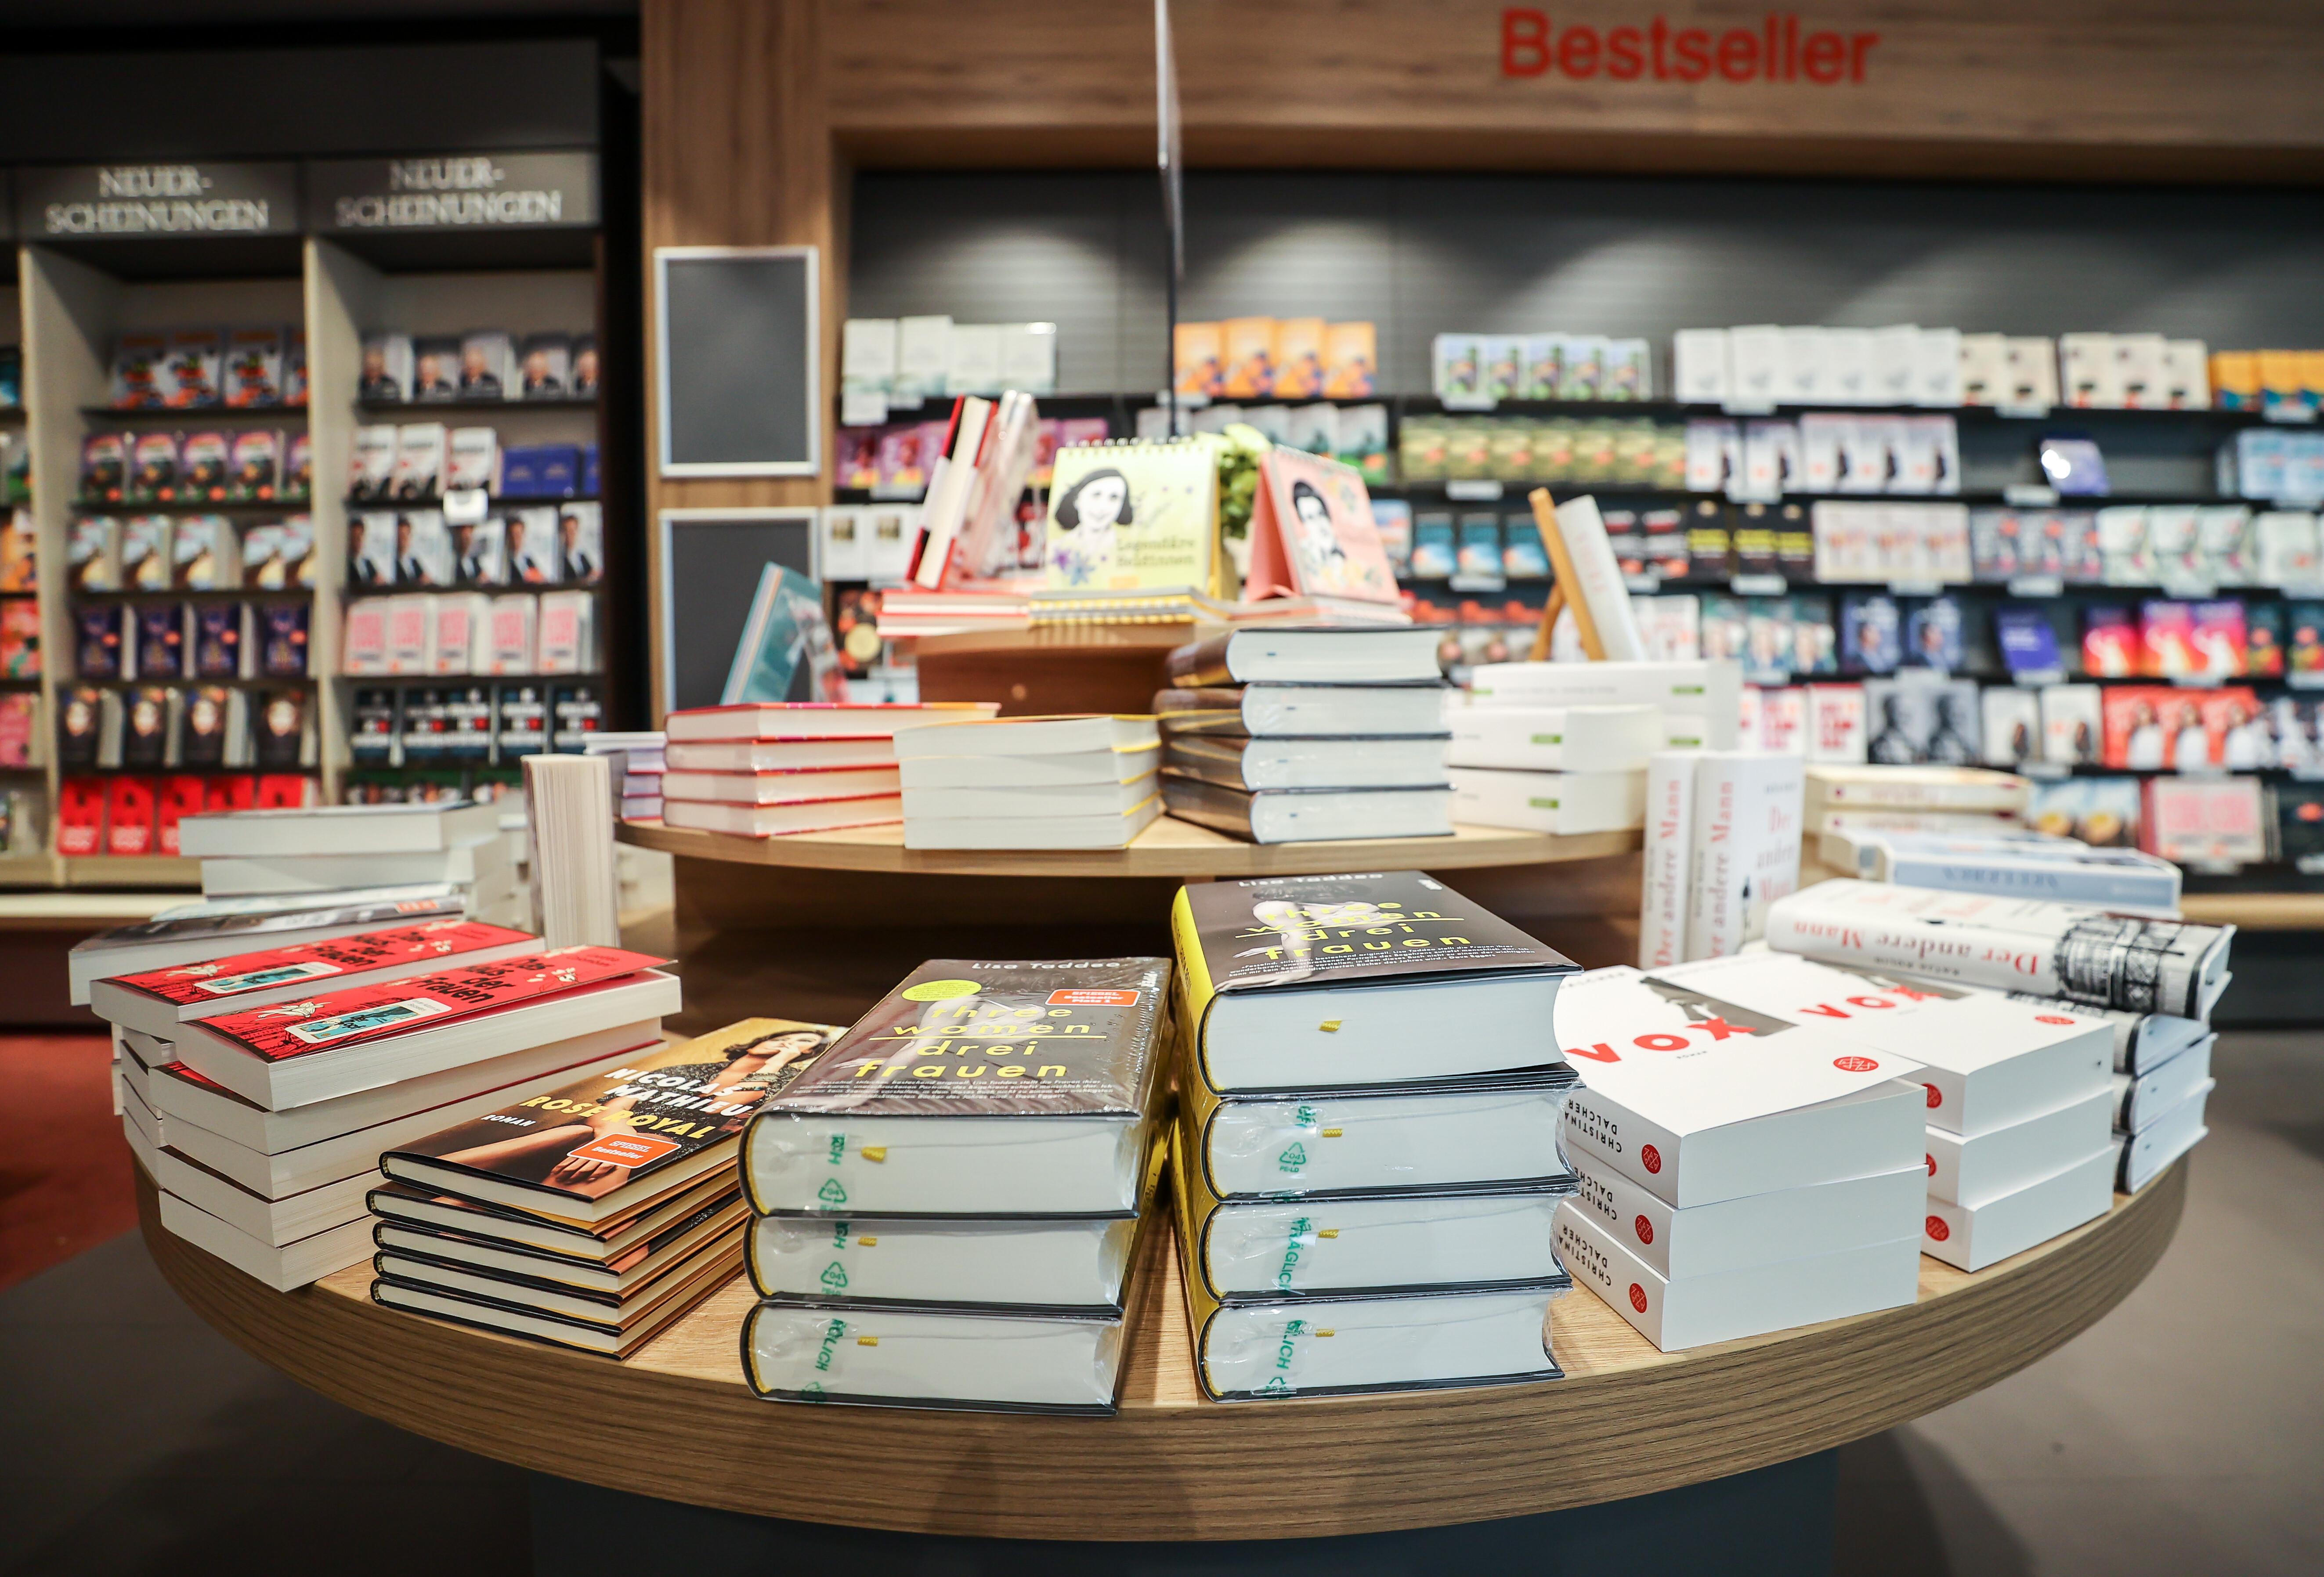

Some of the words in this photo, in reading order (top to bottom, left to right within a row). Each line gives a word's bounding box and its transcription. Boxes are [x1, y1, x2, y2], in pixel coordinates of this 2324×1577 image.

[1500, 7, 1880, 84] Bestseller
[1660, 779, 1681, 839] Mann
[1710, 781, 1734, 841] Mann
[1708, 852, 1729, 929] andere
[1244, 910, 1441, 933] women
[1264, 902, 1402, 920] three
[1300, 923, 1414, 941] drei
[1793, 921, 1864, 950] Mann
[1876, 932, 1972, 959] andere
[1264, 935, 1471, 960] frauen
[1030, 961, 1121, 970] Taddeo
[1981, 948, 2038, 976] Der
[416, 977, 495, 1004] Frauen
[1798, 985, 1941, 1018] VOX
[931, 1006, 1073, 1018] three
[893, 1021, 1091, 1036] women
[1564, 1017, 1757, 1063] VOX
[916, 1040, 1039, 1057] drei
[604, 1068, 744, 1097] NICOLAS
[855, 1060, 1067, 1078] frauen
[604, 1084, 754, 1117] MATHIEU
[481, 1114, 537, 1128] ROMAN
[519, 1096, 608, 1118] ROSE
[603, 1109, 716, 1139] ROYAL
[1569, 1099, 1617, 1135] DALCHER
[608, 1140, 653, 1152] SPIEGEL
[1565, 1111, 1622, 1153] CHRISTINA
[591, 1146, 643, 1159] Bestseller
[1570, 1166, 1613, 1202] DALCHE
[1563, 1224, 1608, 1269] DALCHER
